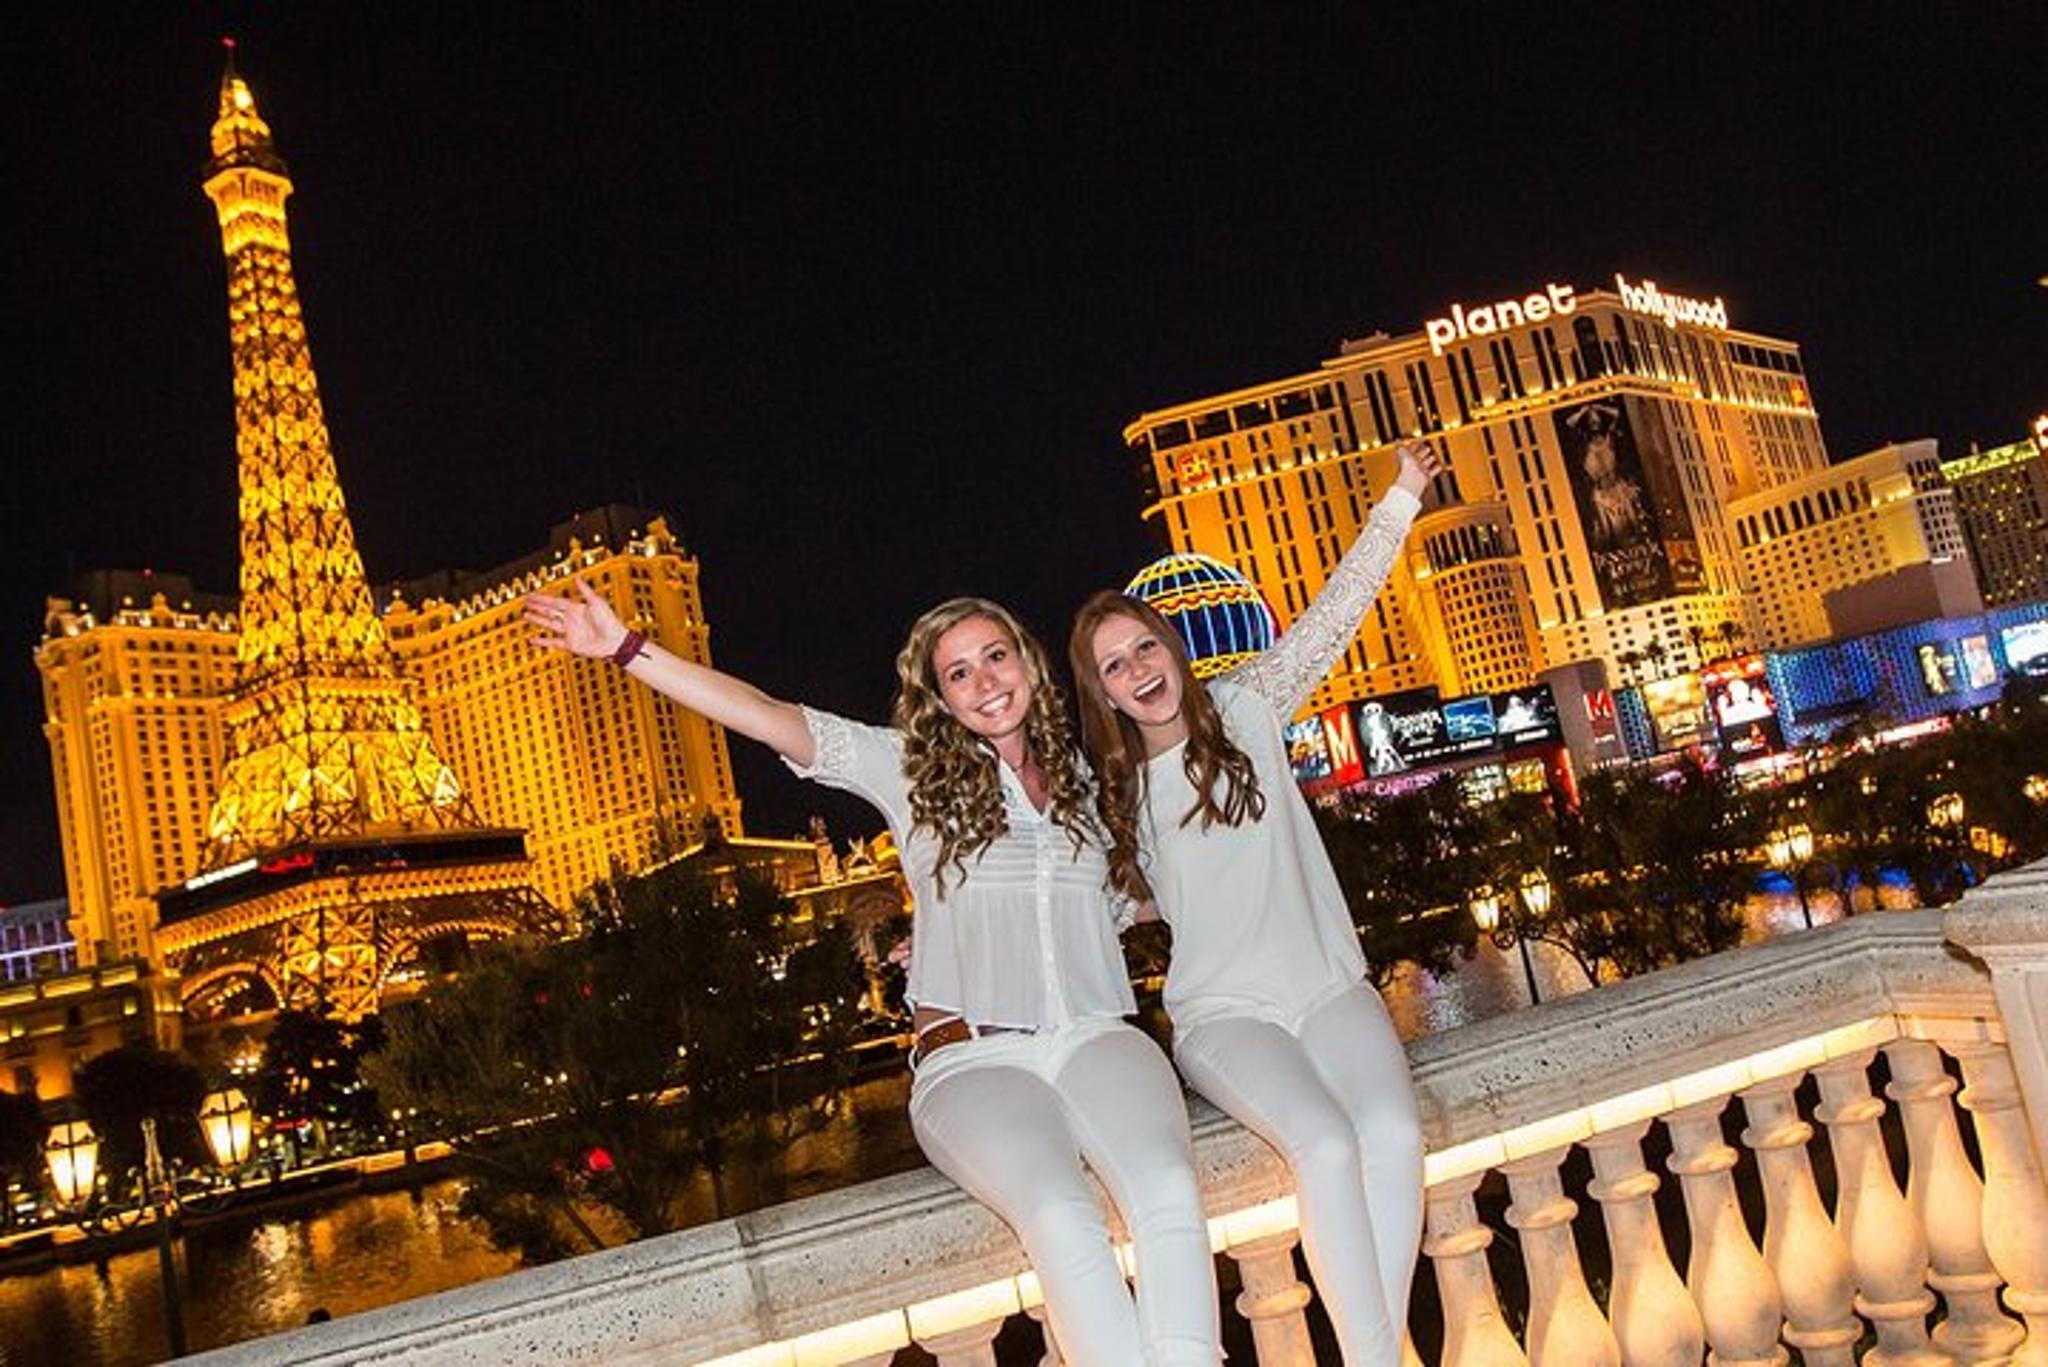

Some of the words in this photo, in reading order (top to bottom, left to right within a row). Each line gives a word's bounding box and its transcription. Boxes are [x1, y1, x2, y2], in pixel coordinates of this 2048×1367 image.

[1426, 283, 1577, 356] planet
[1615, 272, 1729, 331] hollywood
[1583, 688, 1613, 721] M
[1324, 711, 1359, 770] M
